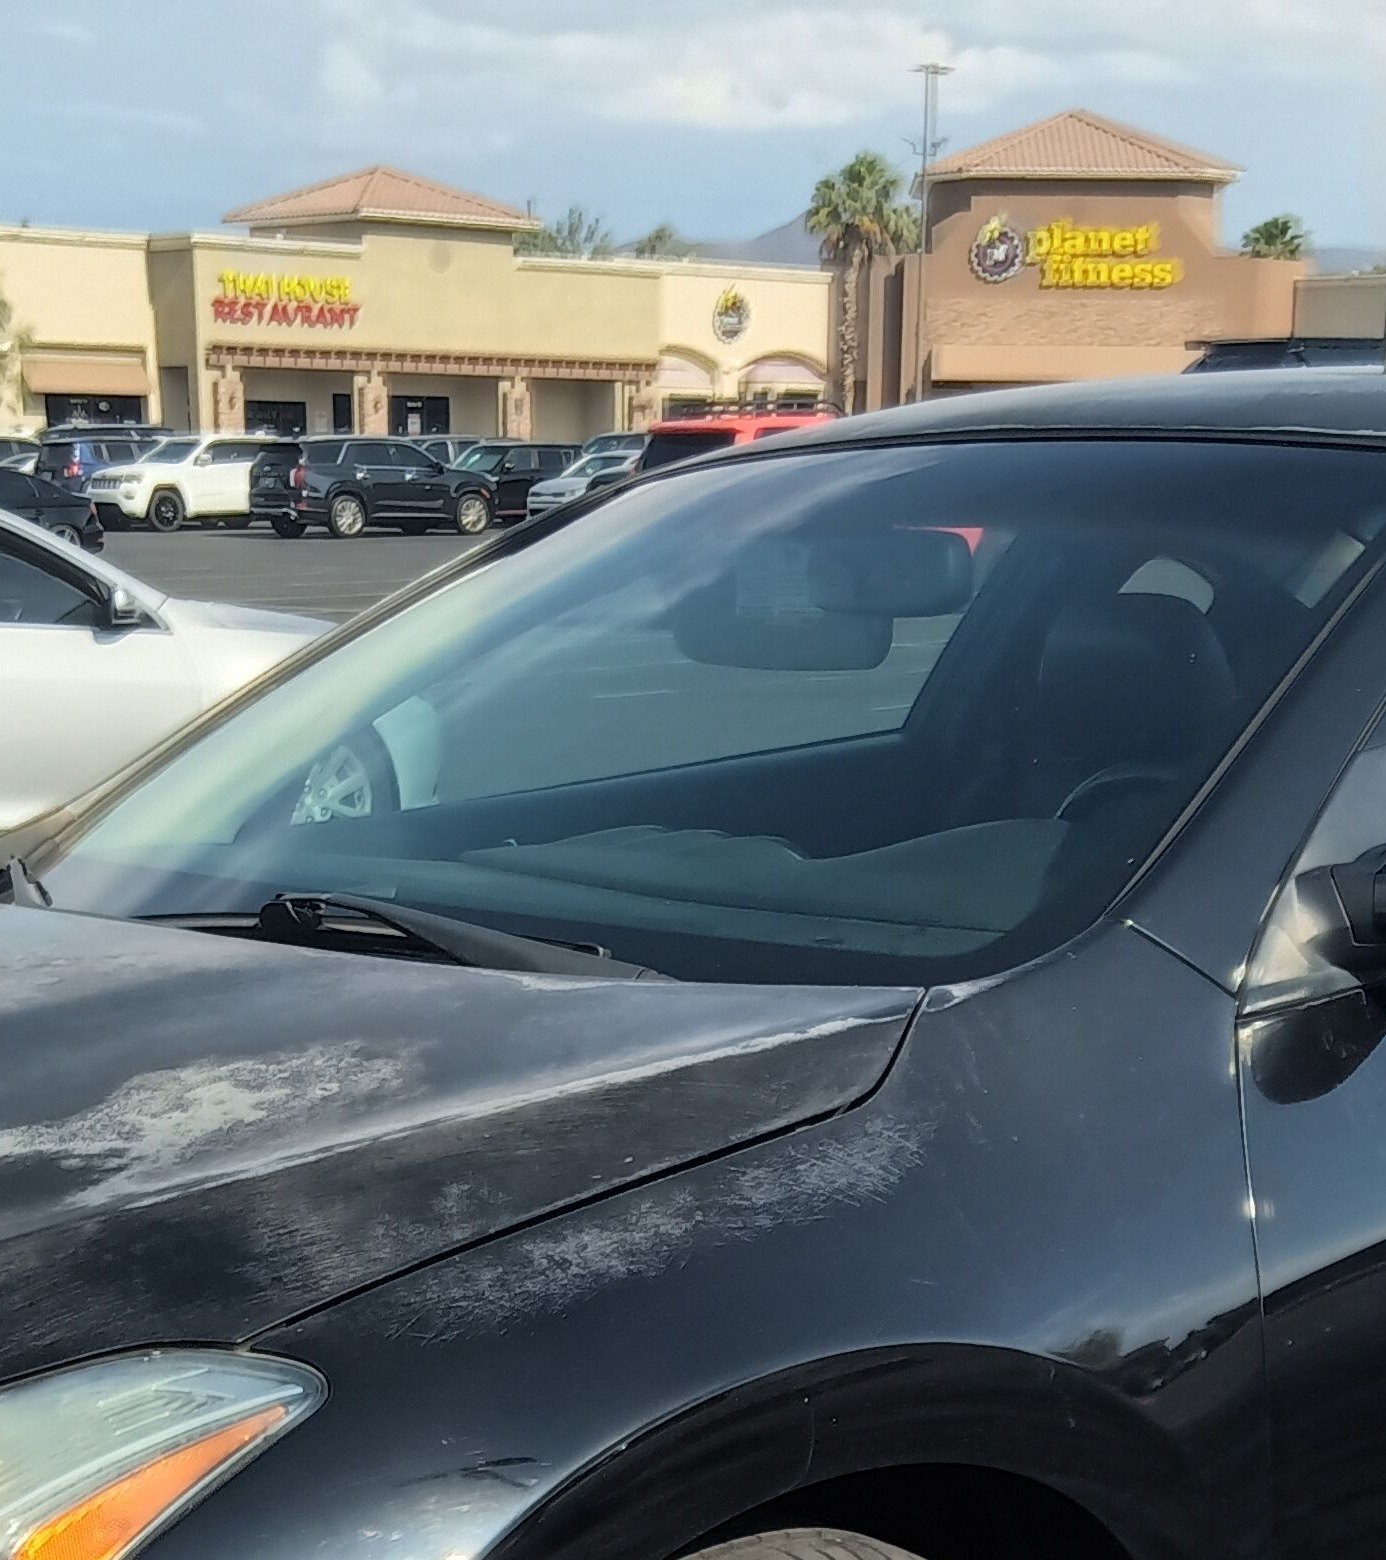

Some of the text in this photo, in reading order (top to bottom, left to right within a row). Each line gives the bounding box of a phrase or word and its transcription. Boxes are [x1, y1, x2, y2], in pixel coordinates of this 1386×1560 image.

[1026, 220, 1156, 265] planet
[218, 270, 351, 305] THAI HOUSE
[1040, 254, 1175, 289] fitness
[211, 300, 361, 330] RESTAURANT
